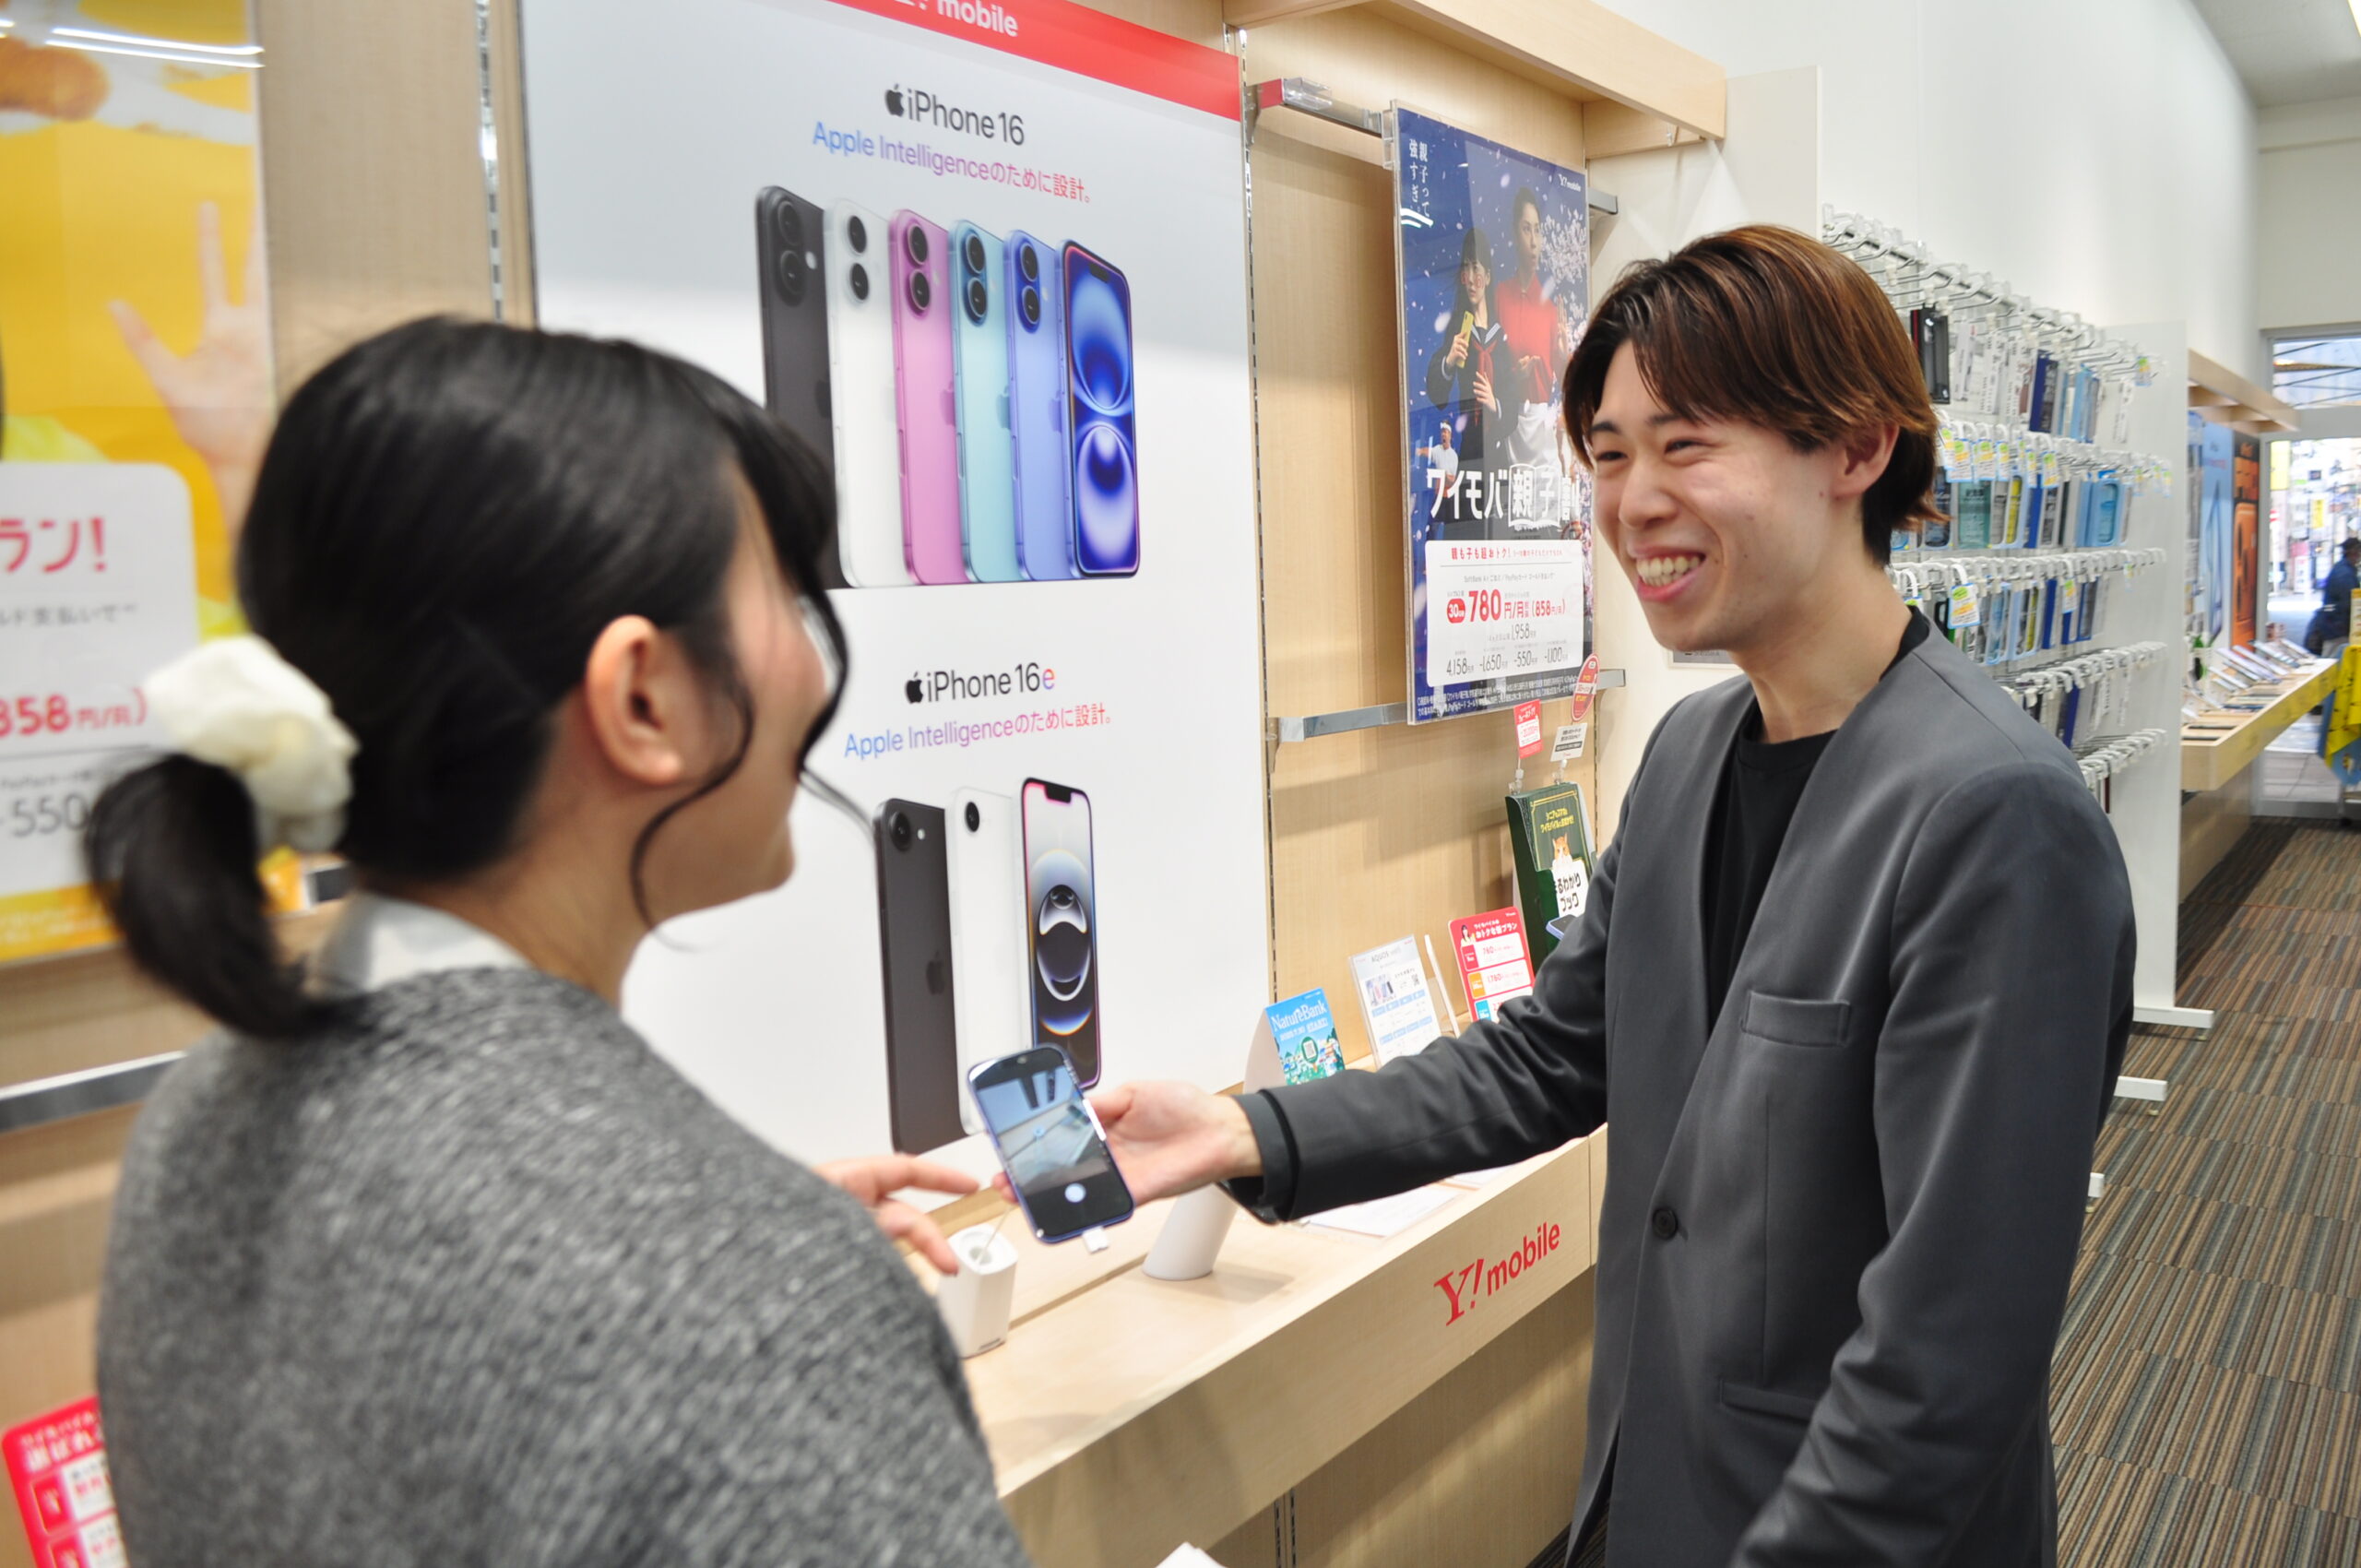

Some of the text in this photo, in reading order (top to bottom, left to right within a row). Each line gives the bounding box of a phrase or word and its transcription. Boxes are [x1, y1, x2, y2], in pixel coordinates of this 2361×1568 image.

[895, 0, 1018, 37] mobile
[908, 89, 1025, 146] iPhone 16
[813, 122, 875, 158] Apple
[927, 662, 1055, 703] iPhone 16e
[844, 730, 903, 760] Apple
[1271, 1000, 1328, 1032] NatureBank
[1433, 1221, 1560, 1326] Y!mobile
